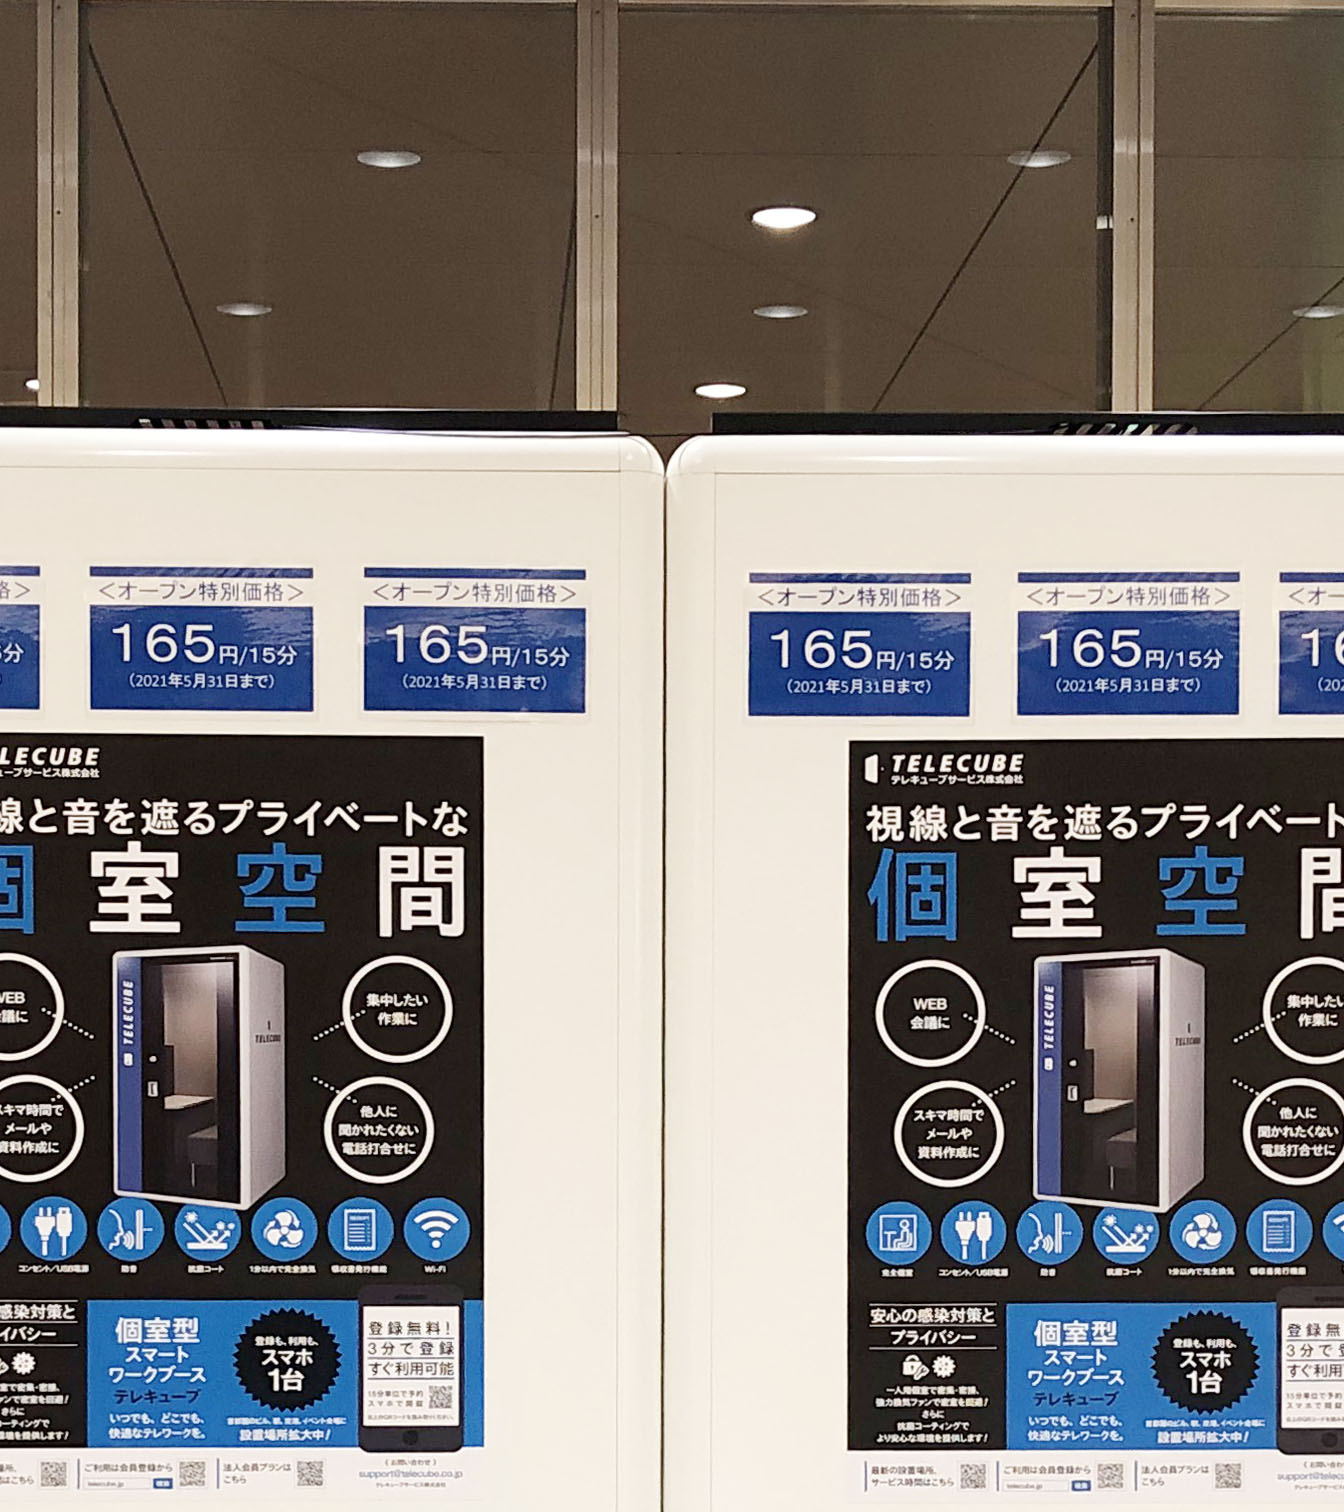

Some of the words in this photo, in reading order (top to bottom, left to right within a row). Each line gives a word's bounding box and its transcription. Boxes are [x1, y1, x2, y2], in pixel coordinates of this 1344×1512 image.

[891, 753, 1024, 773] TELECUBE
[890, 774, 1024, 785] テレキューブサービス株式会社
[366, 993, 428, 1007] 集中したい
[913, 998, 947, 1010] WEB
[123, 979, 135, 1045] TELECUBE
[377, 1011, 417, 1025] 作業に
[1043, 985, 1055, 1050] TELECUBE
[910, 1016, 950, 1030] 会議に
[1298, 1013, 1338, 1027] 作業に
[360, 1105, 398, 1118] 他人に
[913, 1108, 985, 1121] スキマ時間で
[1280, 1106, 1318, 1120] 他人に
[5, 1122, 52, 1135] メールや
[338, 1123, 419, 1137] 聞かれたくない
[926, 1127, 973, 1140] メールや
[1257, 1124, 1339, 1138] 聞かれたくない
[341, 1141, 416, 1156] 電話打合せに
[917, 1145, 980, 1159] 資料作成に
[1261, 1143, 1336, 1157] 電話打合せに
[424, 1264, 447, 1273] Wi-Fi
[870, 1308, 995, 1324] 安心の感染対策と
[115, 1317, 200, 1344] 個室型
[890, 1329, 976, 1345] プライバシー
[1034, 1320, 1118, 1347] 個室型
[125, 1347, 189, 1363] スマート
[367, 1342, 454, 1356] 3分で登録
[261, 1349, 313, 1365] スマホ
[1044, 1350, 1107, 1366] スマート
[1179, 1351, 1232, 1368] スマホ
[108, 1366, 206, 1383] ワークブース
[368, 1361, 454, 1377] すぐ利用可能
[267, 1369, 305, 1392] 1台
[1027, 1369, 1124, 1386] ワークブース
[1186, 1371, 1223, 1394] 1台
[114, 1388, 201, 1404] テレキューブ
[1032, 1390, 1119, 1406] テレキューブ
[223, 1475, 247, 1485] こちら
[871, 1477, 954, 1487] サービス時間はこちら
[1141, 1477, 1165, 1486] こちら
